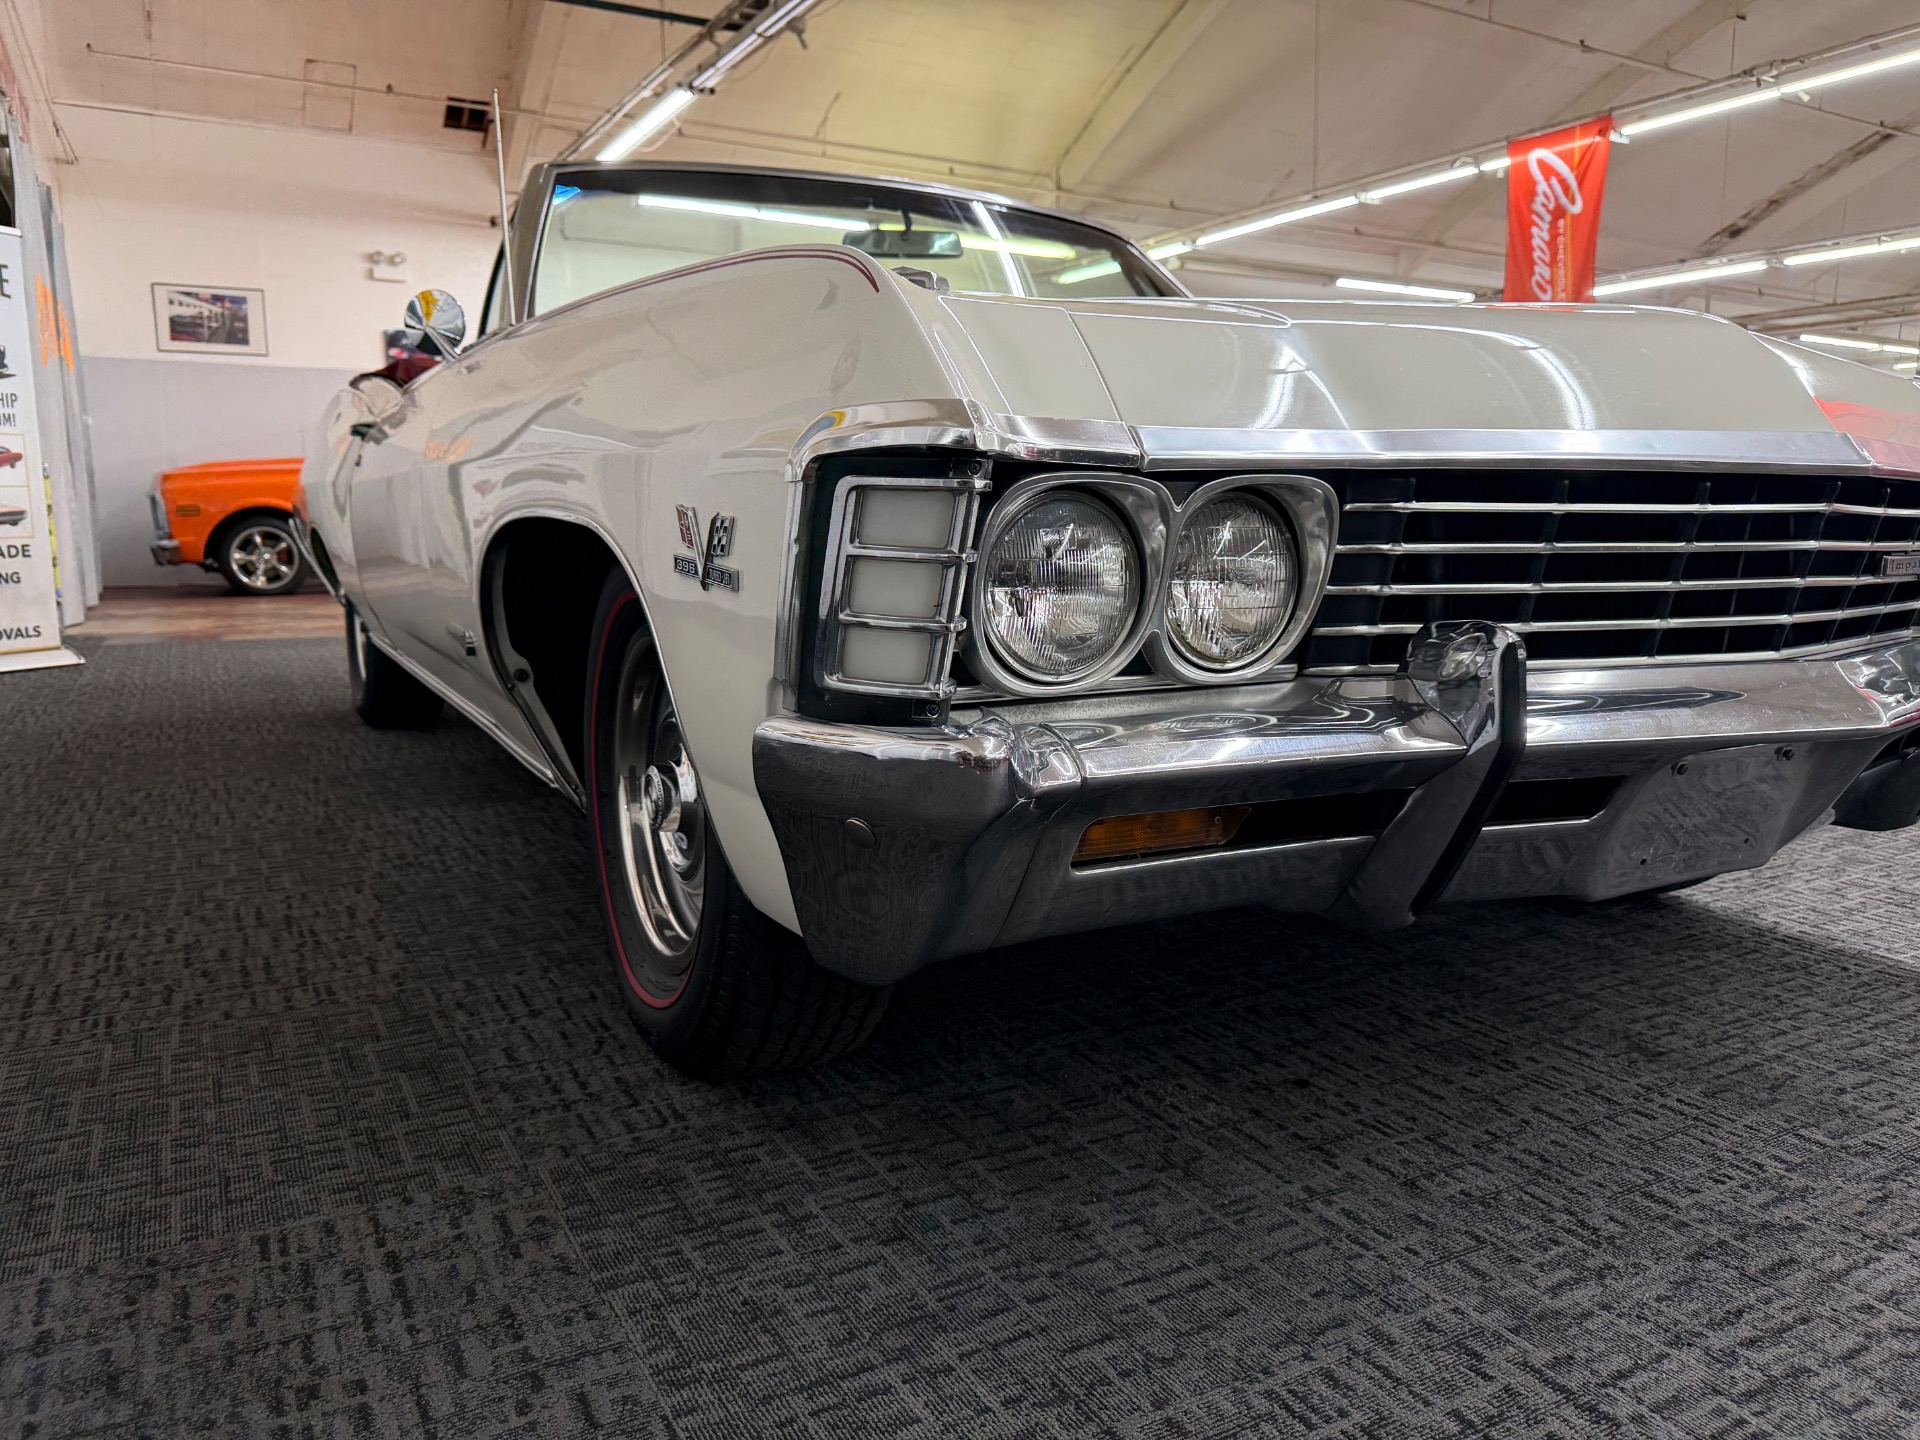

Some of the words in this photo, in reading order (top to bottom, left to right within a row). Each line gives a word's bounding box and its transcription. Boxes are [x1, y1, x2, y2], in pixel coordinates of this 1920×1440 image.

[1528, 147, 1583, 301] Camaro
[0, 412, 17, 427] M!
[676, 559, 696, 575] 396
[0, 625, 42, 641] VALS
